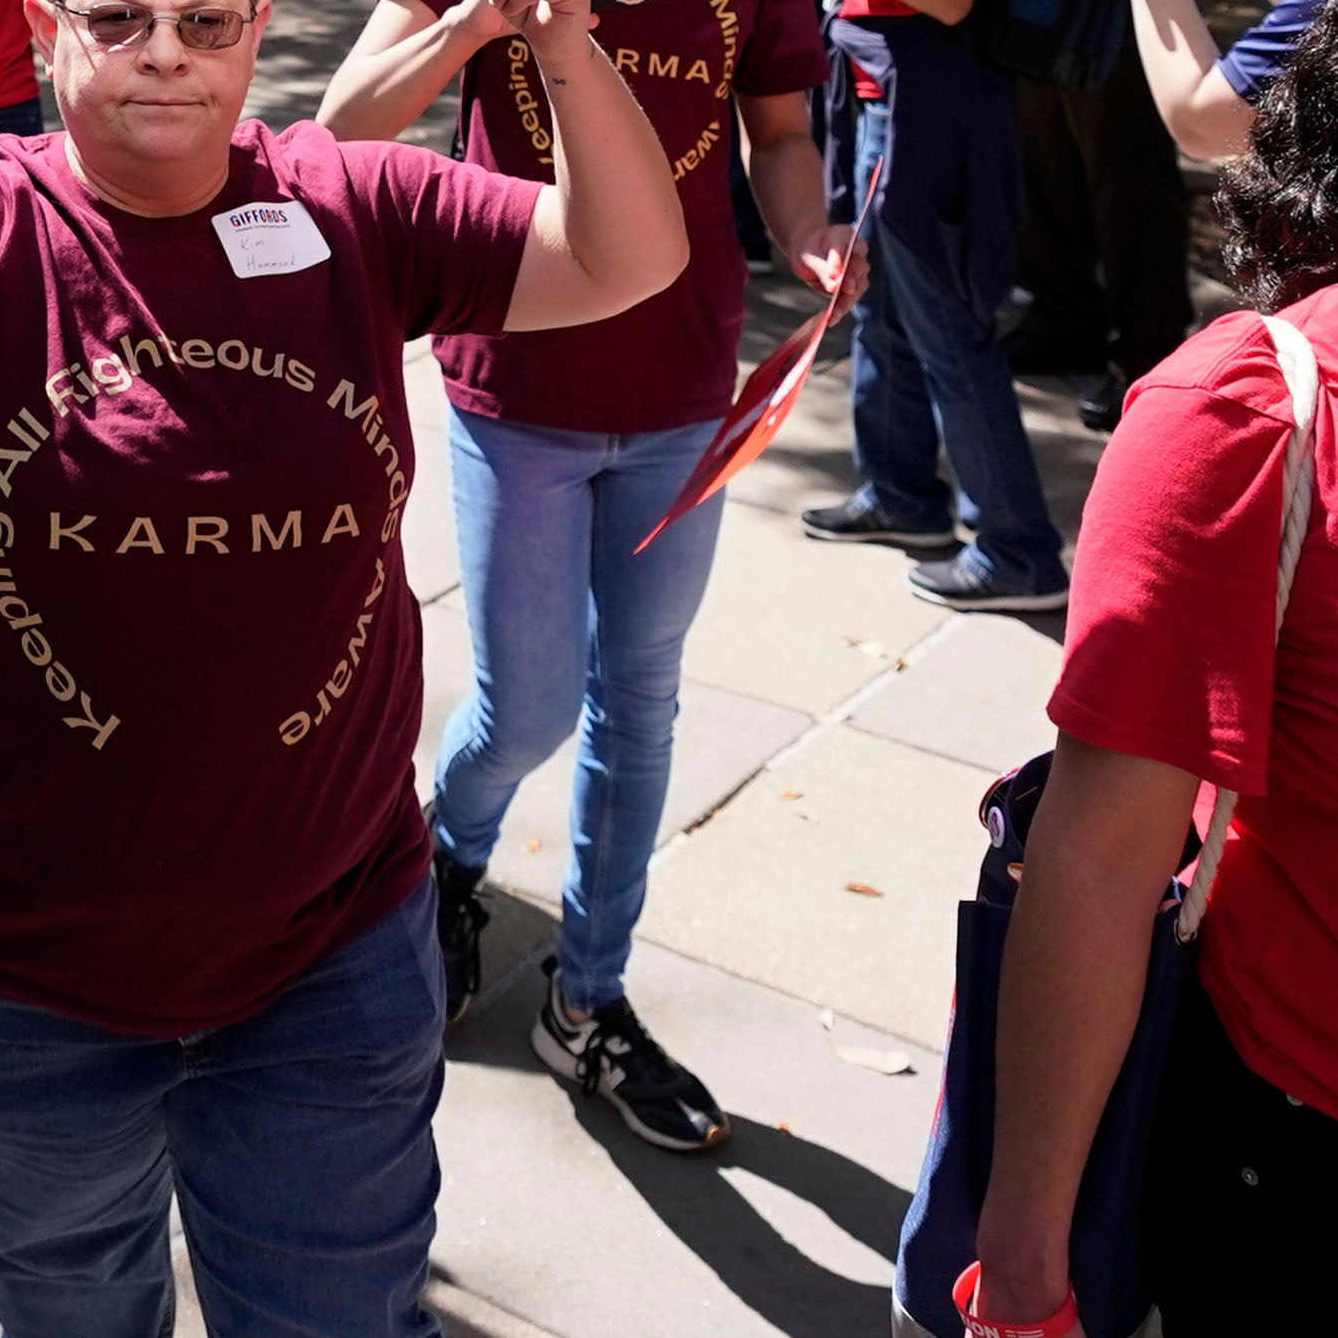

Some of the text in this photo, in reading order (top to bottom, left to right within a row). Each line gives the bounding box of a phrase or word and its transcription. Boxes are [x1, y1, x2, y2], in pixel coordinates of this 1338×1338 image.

[507, 39, 554, 164] eeping
[615, 47, 710, 84] RMA
[230, 209, 288, 228] GIFFORDS
[43, 333, 317, 419] Righteous
[327, 379, 410, 545] Minds
[49, 503, 361, 555] KARMA
[278, 556, 386, 747] Aware
